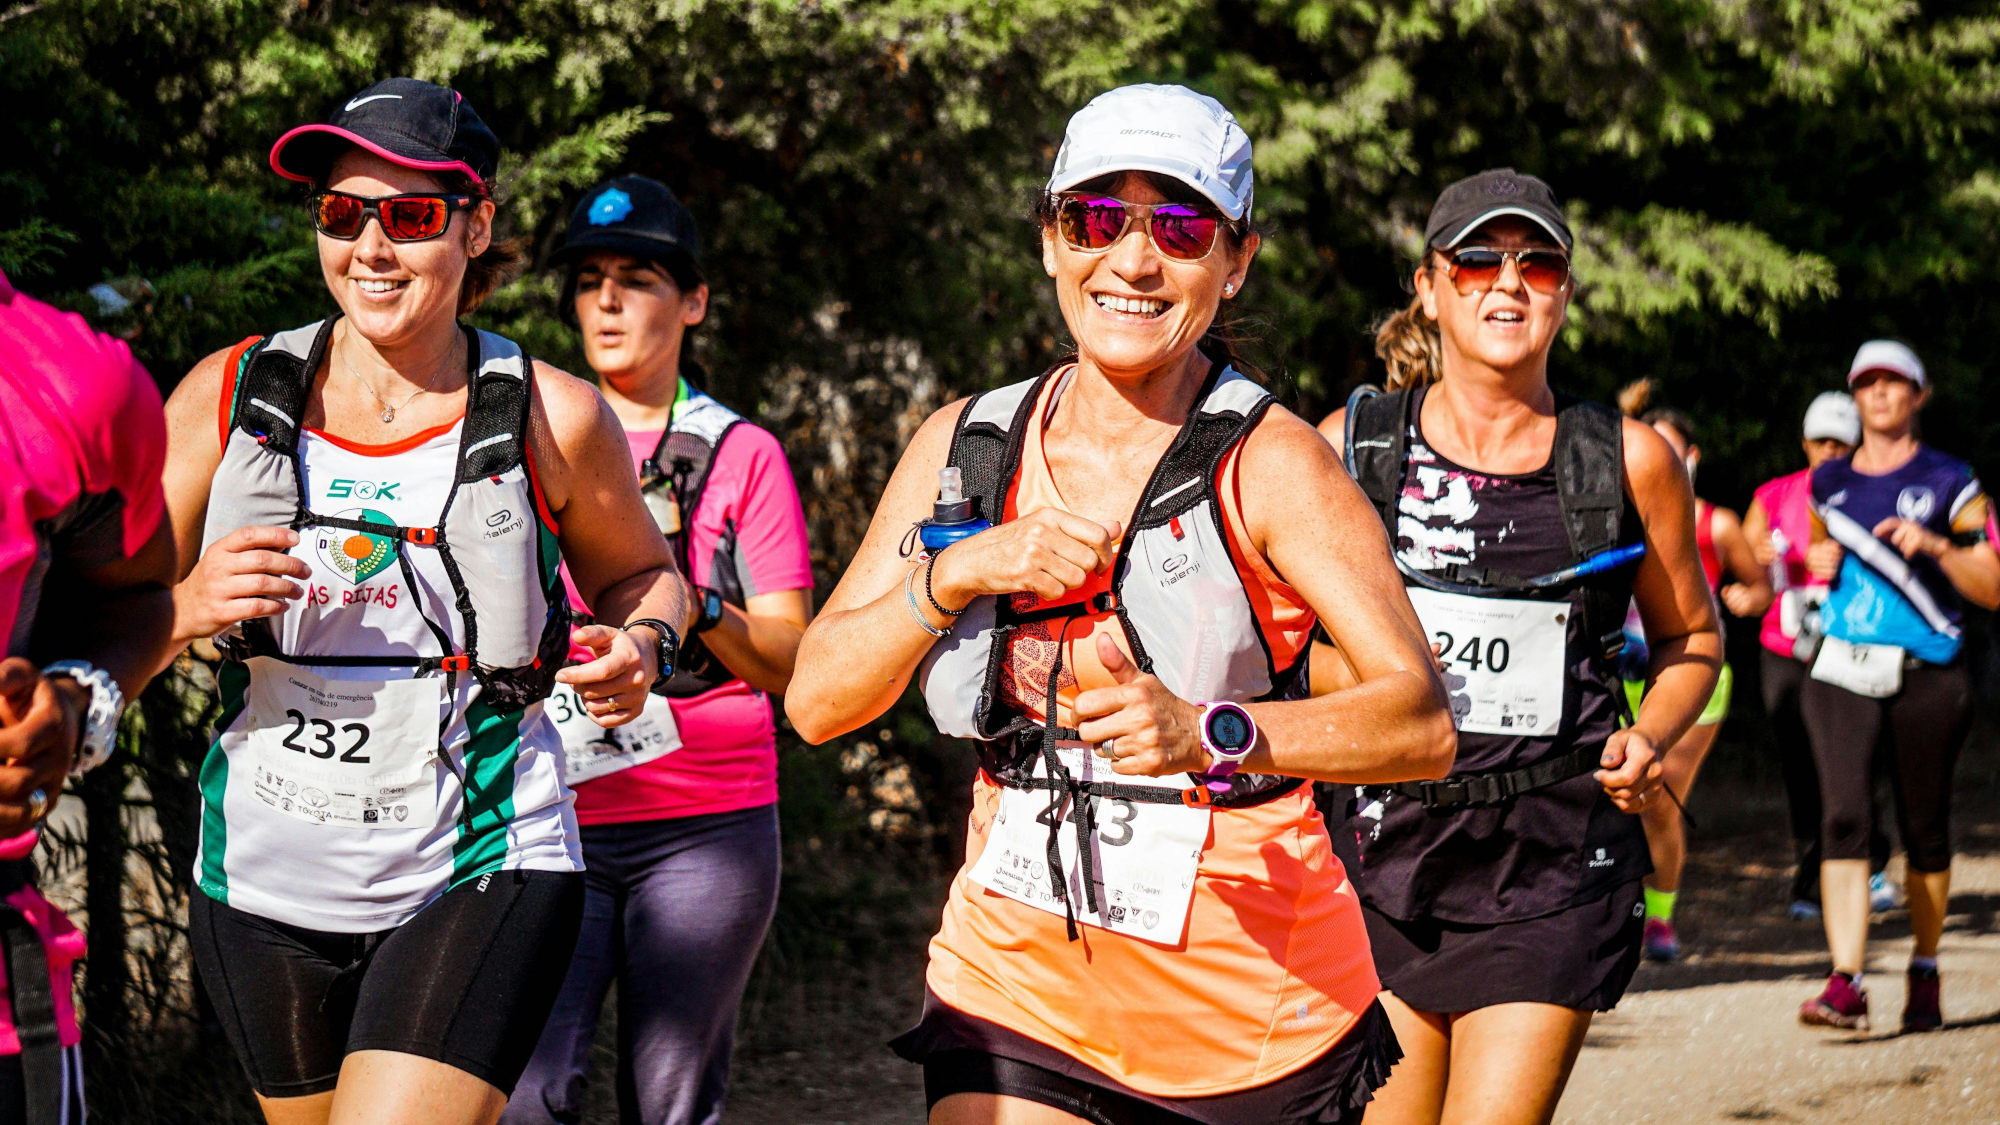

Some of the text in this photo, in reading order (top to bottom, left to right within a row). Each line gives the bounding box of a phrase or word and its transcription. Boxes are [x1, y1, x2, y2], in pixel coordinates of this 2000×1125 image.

[1120, 129, 1176, 139] OUTPACE
[483, 517, 524, 539] Kalenji
[1160, 560, 1201, 587] Kalenji
[343, 584, 398, 609] RIJAS
[1435, 631, 1510, 673] 240
[337, 693, 374, 702] emergência
[282, 708, 371, 764] 232
